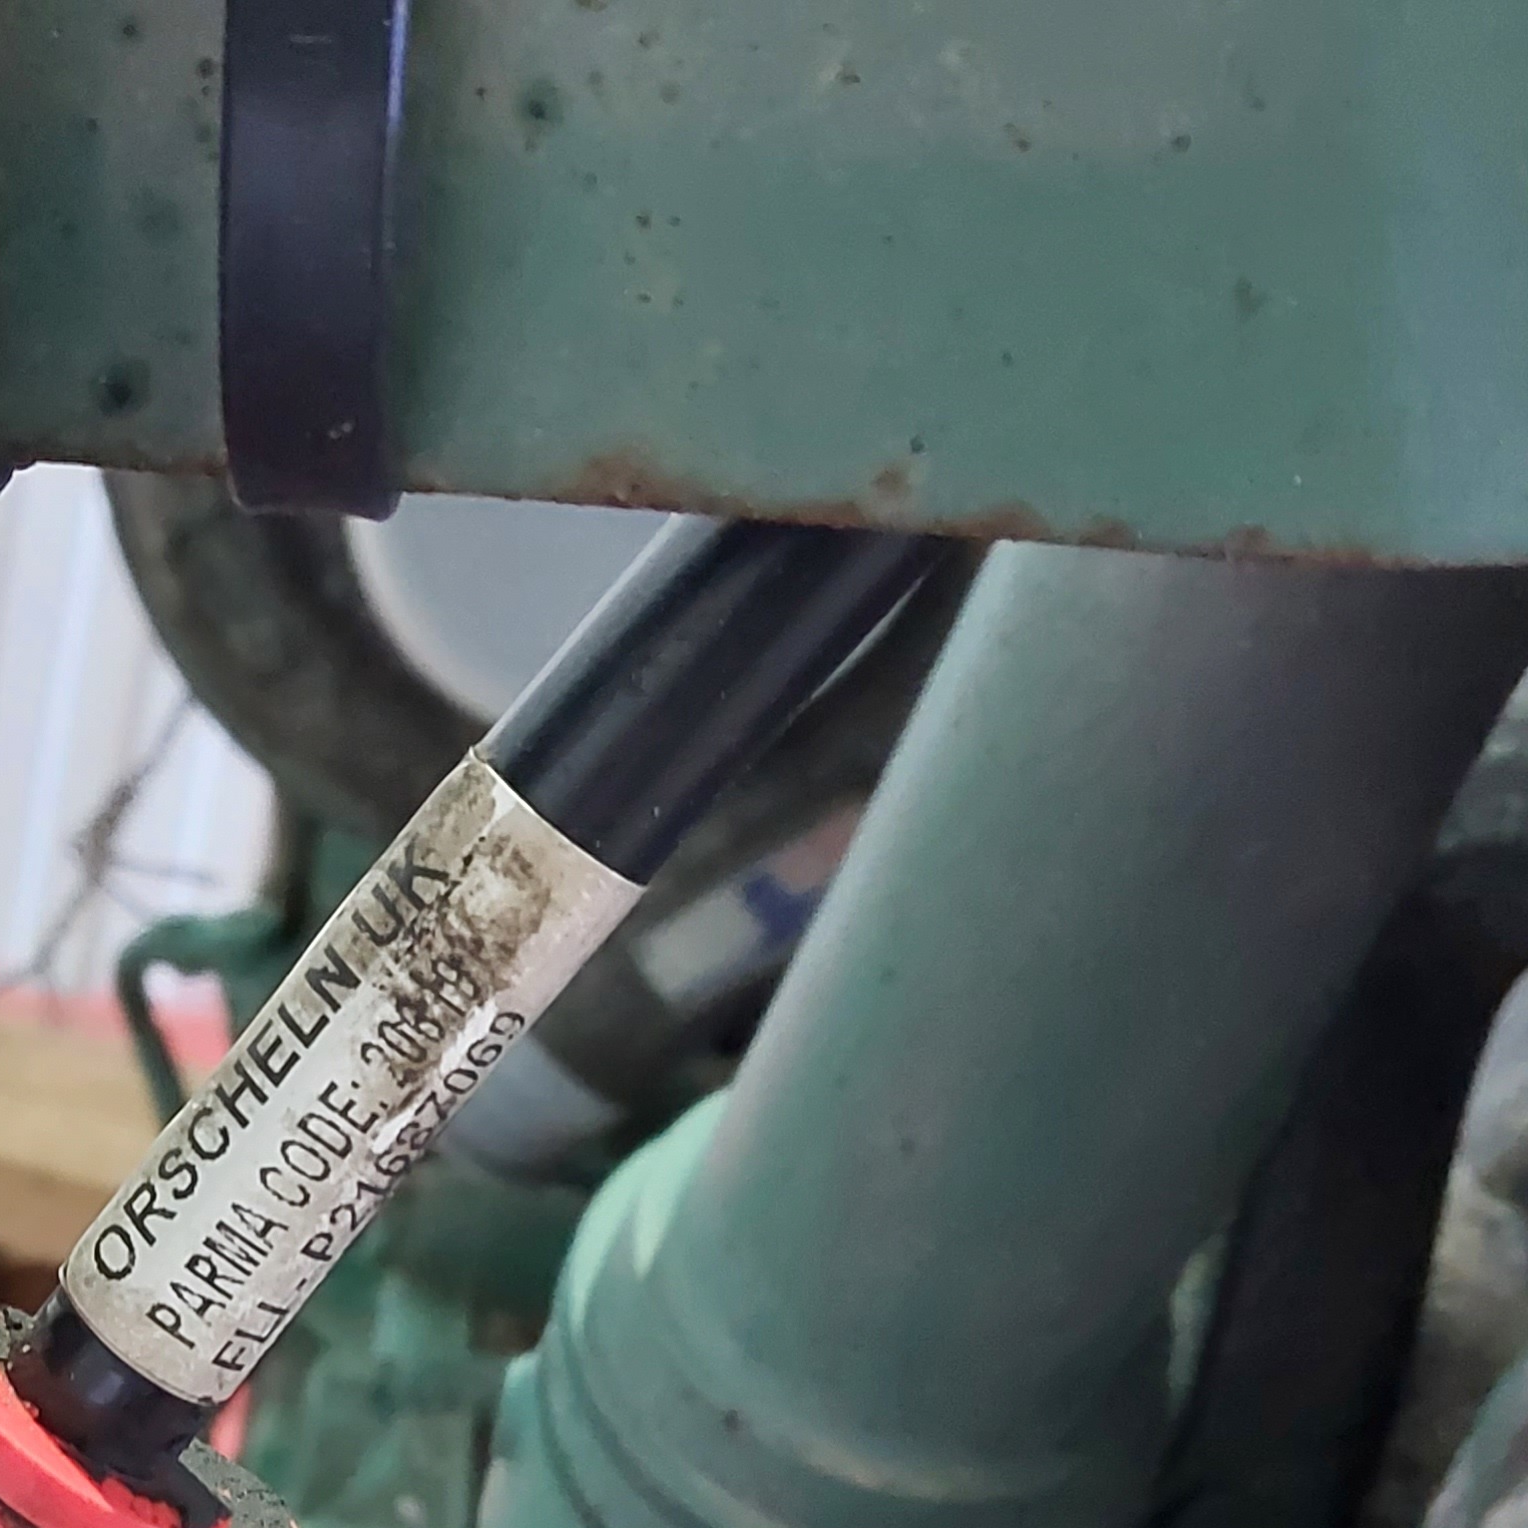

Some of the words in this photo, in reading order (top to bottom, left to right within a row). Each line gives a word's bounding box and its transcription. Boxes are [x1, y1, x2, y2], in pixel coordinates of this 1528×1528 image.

[92, 941, 363, 1280] ORSCHELN
[351, 841, 450, 943] UK
[144, 1207, 289, 1348] PARMA
[260, 1082, 390, 1207] CODE:
